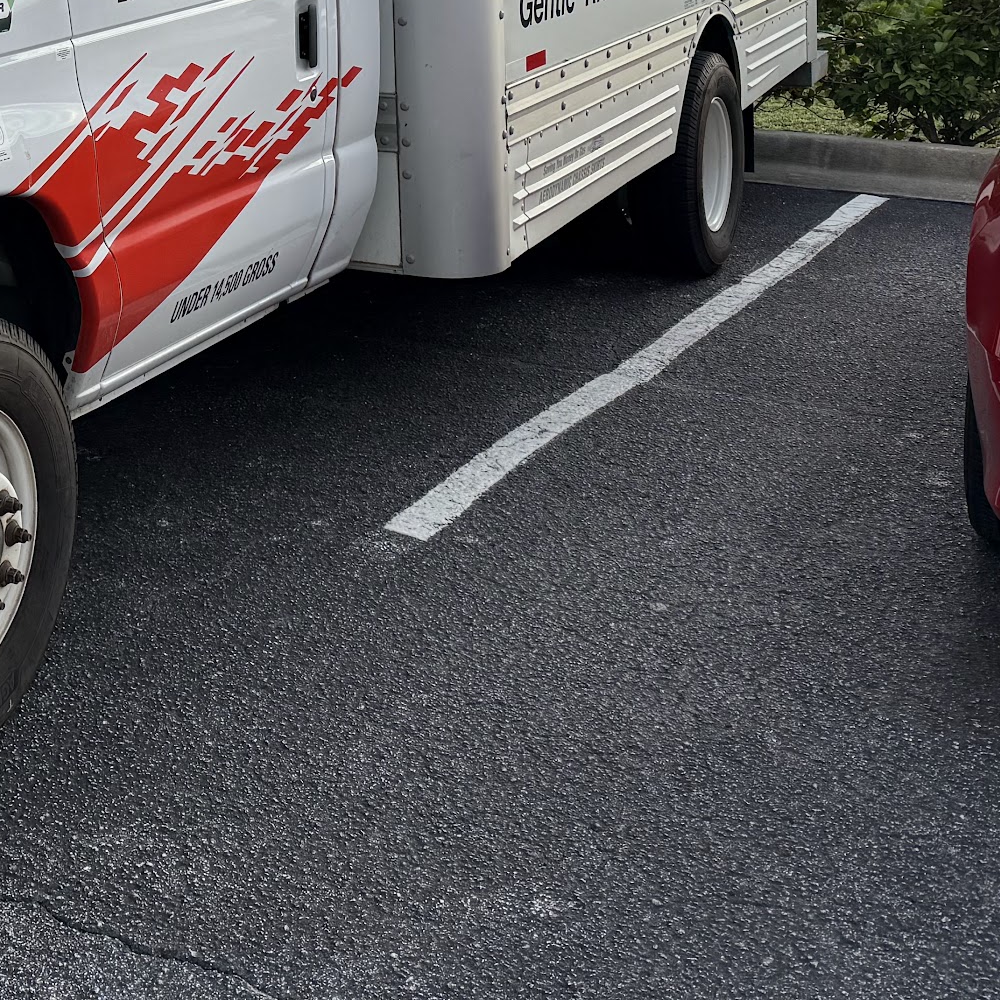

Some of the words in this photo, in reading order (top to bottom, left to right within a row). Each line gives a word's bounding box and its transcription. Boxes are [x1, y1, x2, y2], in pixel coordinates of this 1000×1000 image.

[169, 284, 212, 324] UNDER
[210, 268, 244, 302] 14,500
[241, 251, 279, 287] GROSS
